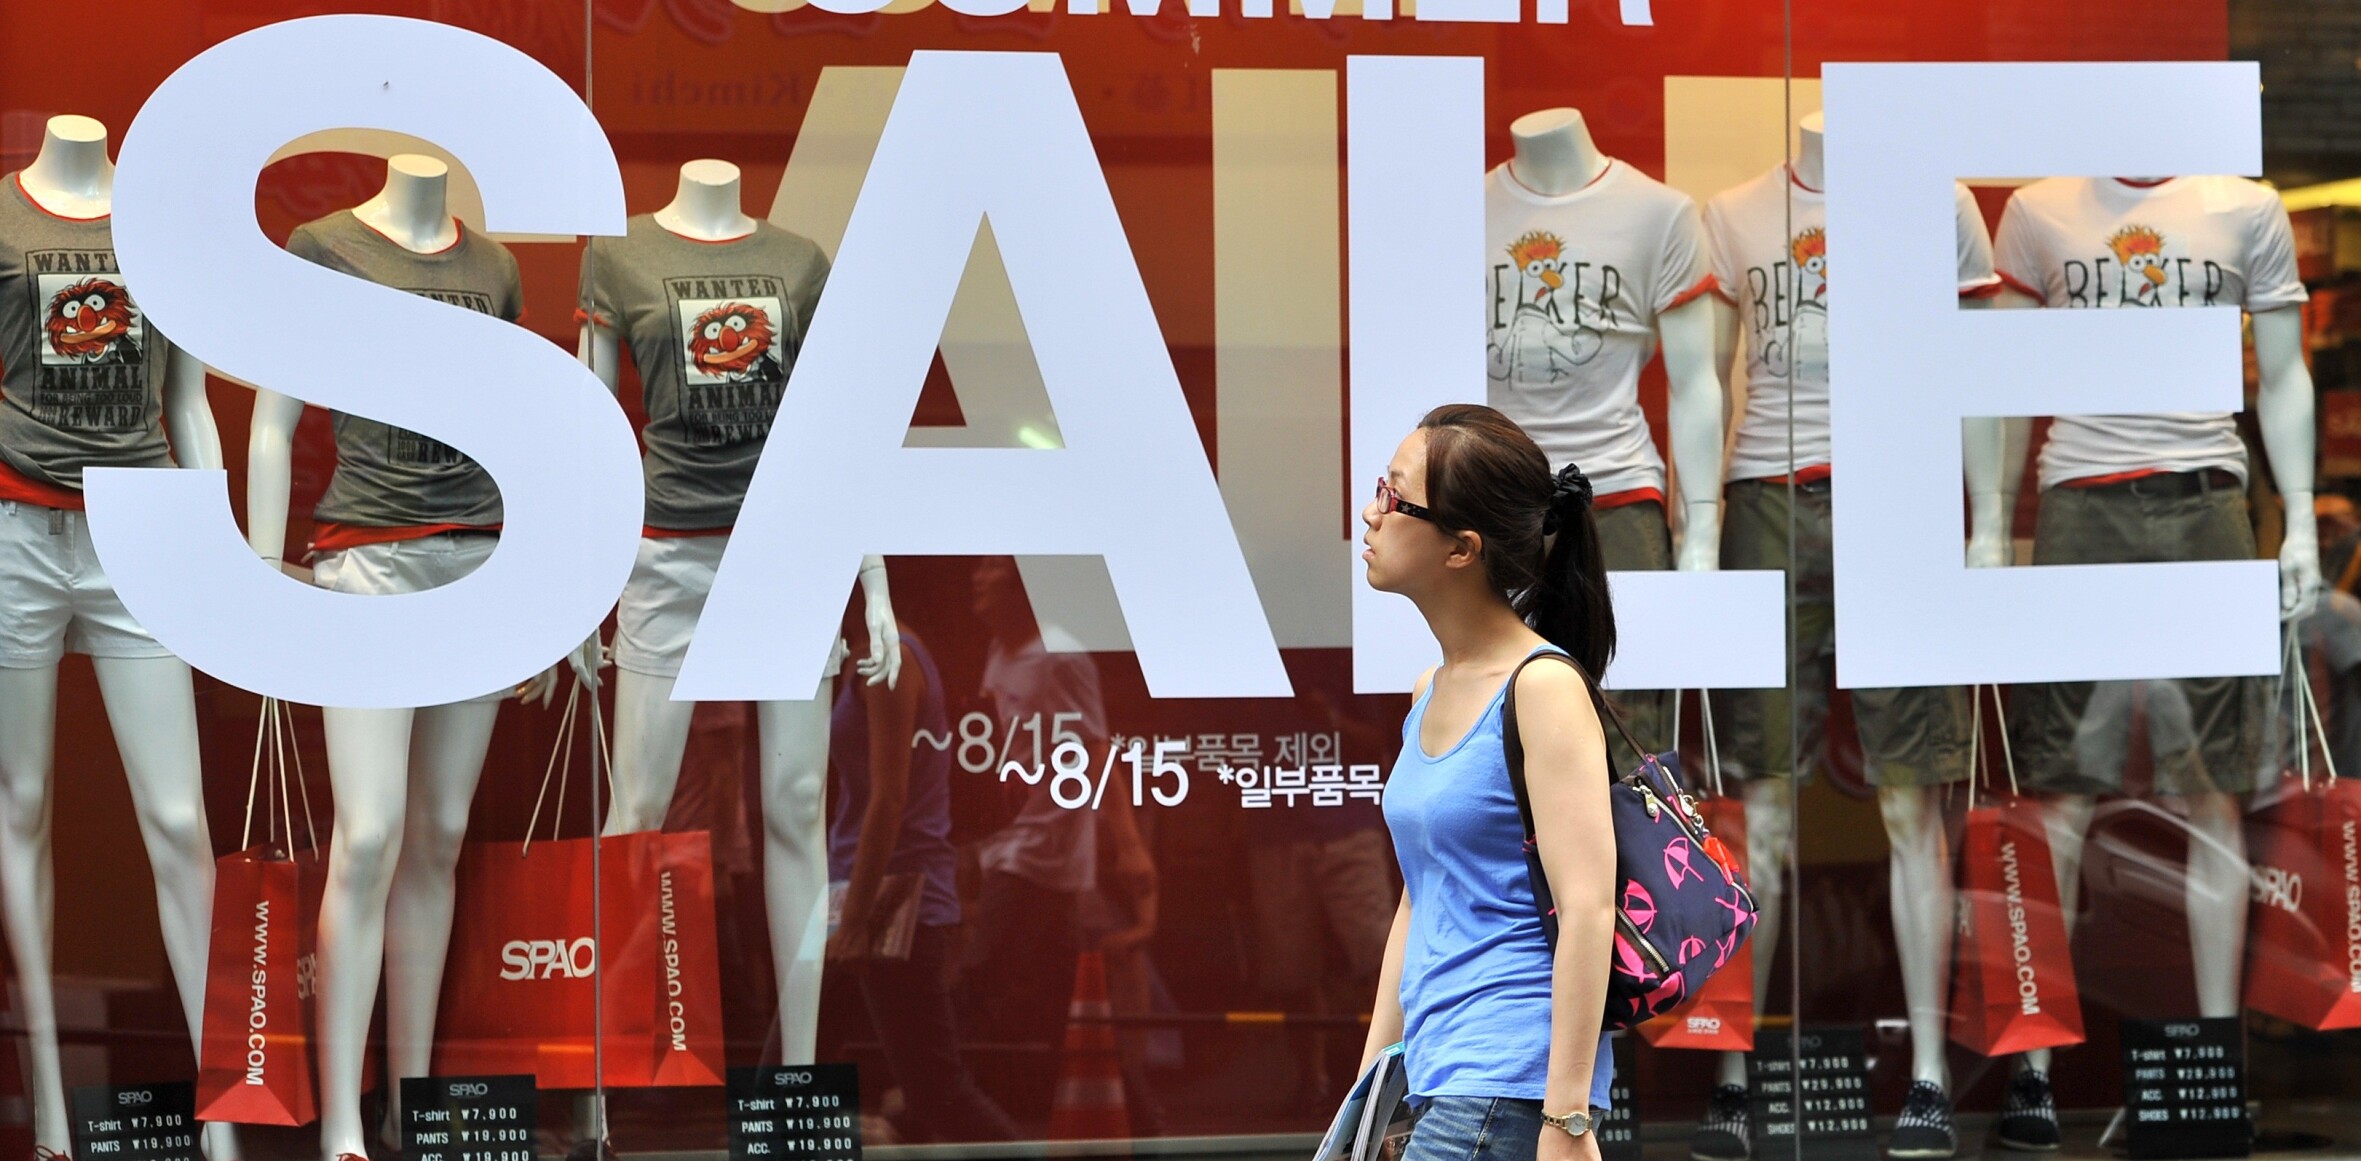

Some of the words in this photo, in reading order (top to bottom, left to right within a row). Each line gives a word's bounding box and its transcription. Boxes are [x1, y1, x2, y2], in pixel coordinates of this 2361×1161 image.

[33, 253, 119, 272] WANT
[671, 278, 778, 299] WANTED
[84, 14, 2281, 706] SALE
[41, 366, 142, 390] ANIMAL
[59, 405, 140, 427] REWARD
[1000, 740, 1190, 810] ~8/15
[2002, 842, 2041, 1016] WWW.SPAO.COM
[499, 936, 596, 981] SPAO
[245, 900, 270, 1087] WWW.SPAO.COM
[774, 1071, 812, 1086] SPAO
[118, 1090, 153, 1105] SPAO
[449, 1083, 488, 1097] SPAO
[738, 1098, 775, 1111] T-shirt
[412, 1109, 450, 1122] T-shirt
[87, 1119, 122, 1132] T-shirt
[741, 1120, 773, 1133] PANTS
[90, 1140, 121, 1154] PANTS
[416, 1132, 449, 1145] PANTS
